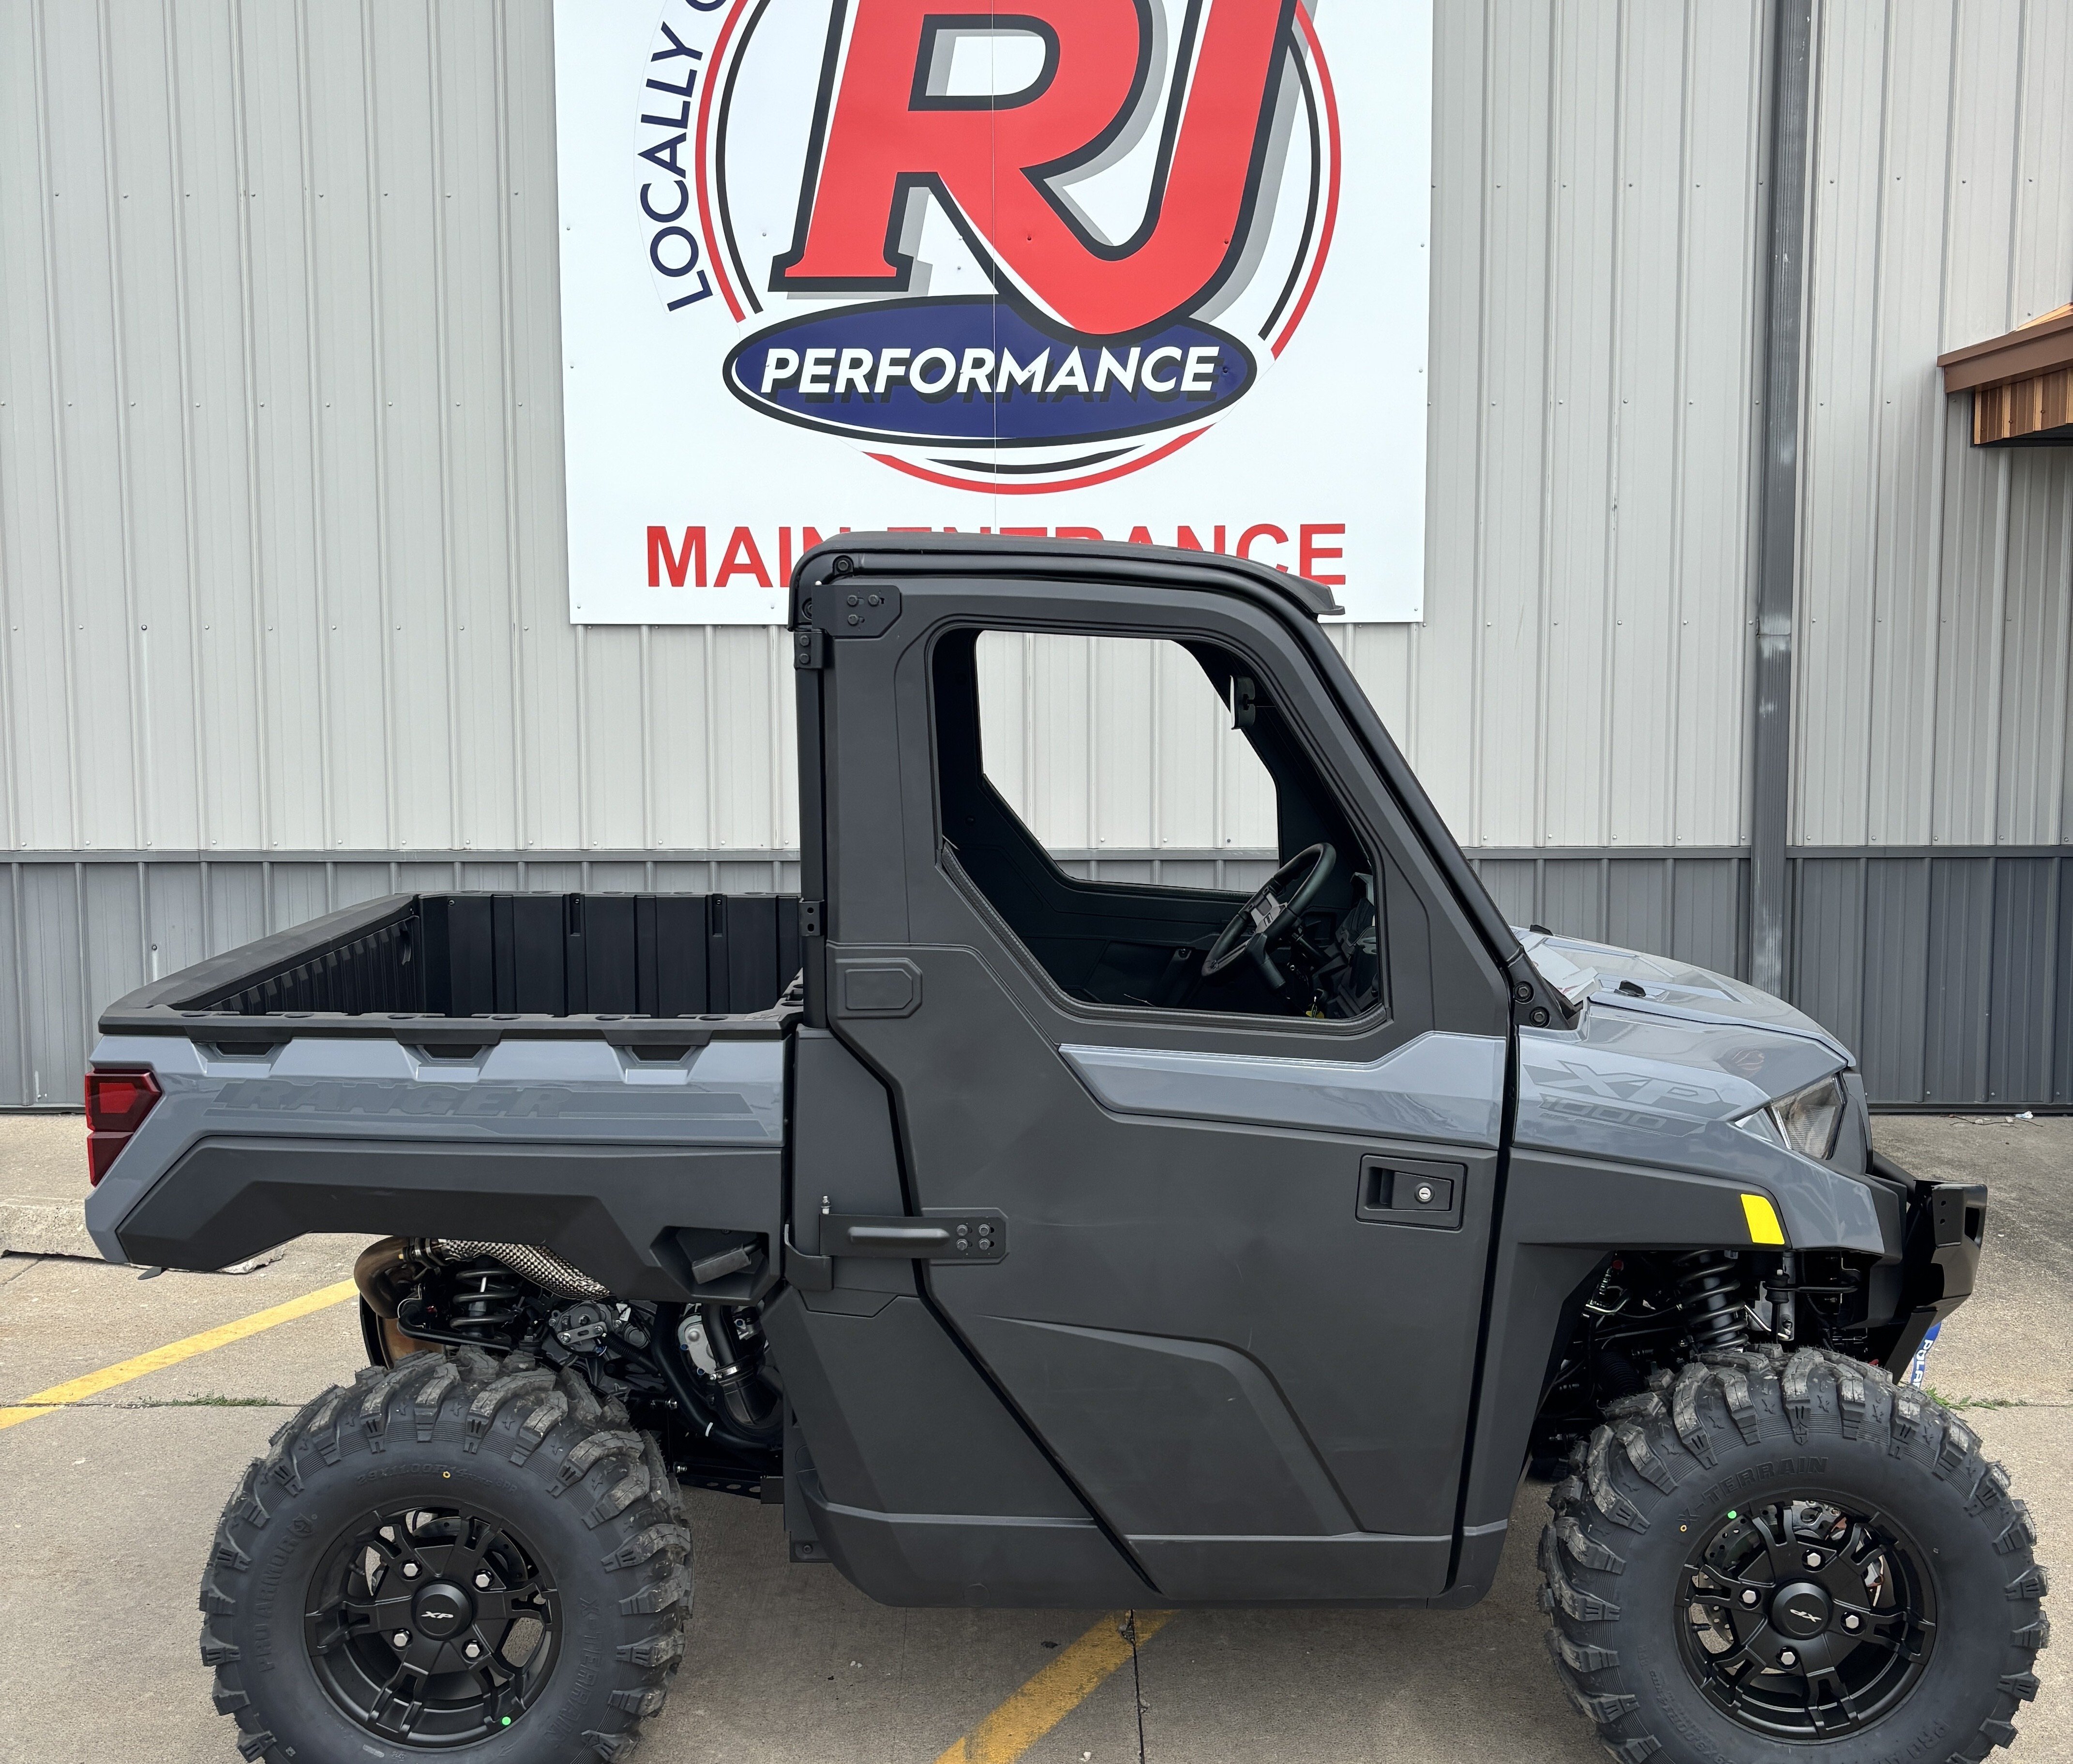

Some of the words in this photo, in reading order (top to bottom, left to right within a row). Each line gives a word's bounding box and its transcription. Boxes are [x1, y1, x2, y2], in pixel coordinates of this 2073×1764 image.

[637, 21, 713, 312] LOCALLY
[772, 0, 1294, 343] RJ
[761, 346, 1219, 393] PERFORMANCE
[647, 526, 851, 587] MAI
[225, 1079, 572, 1117] RANGER
[1534, 1060, 1724, 1106] XP
[1539, 1094, 1667, 1129] 1000
[1677, 1456, 1828, 1524] X-TERRAIN
[1790, 1609, 1822, 1623] XP
[543, 1597, 602, 1742] X-TERRAIN
